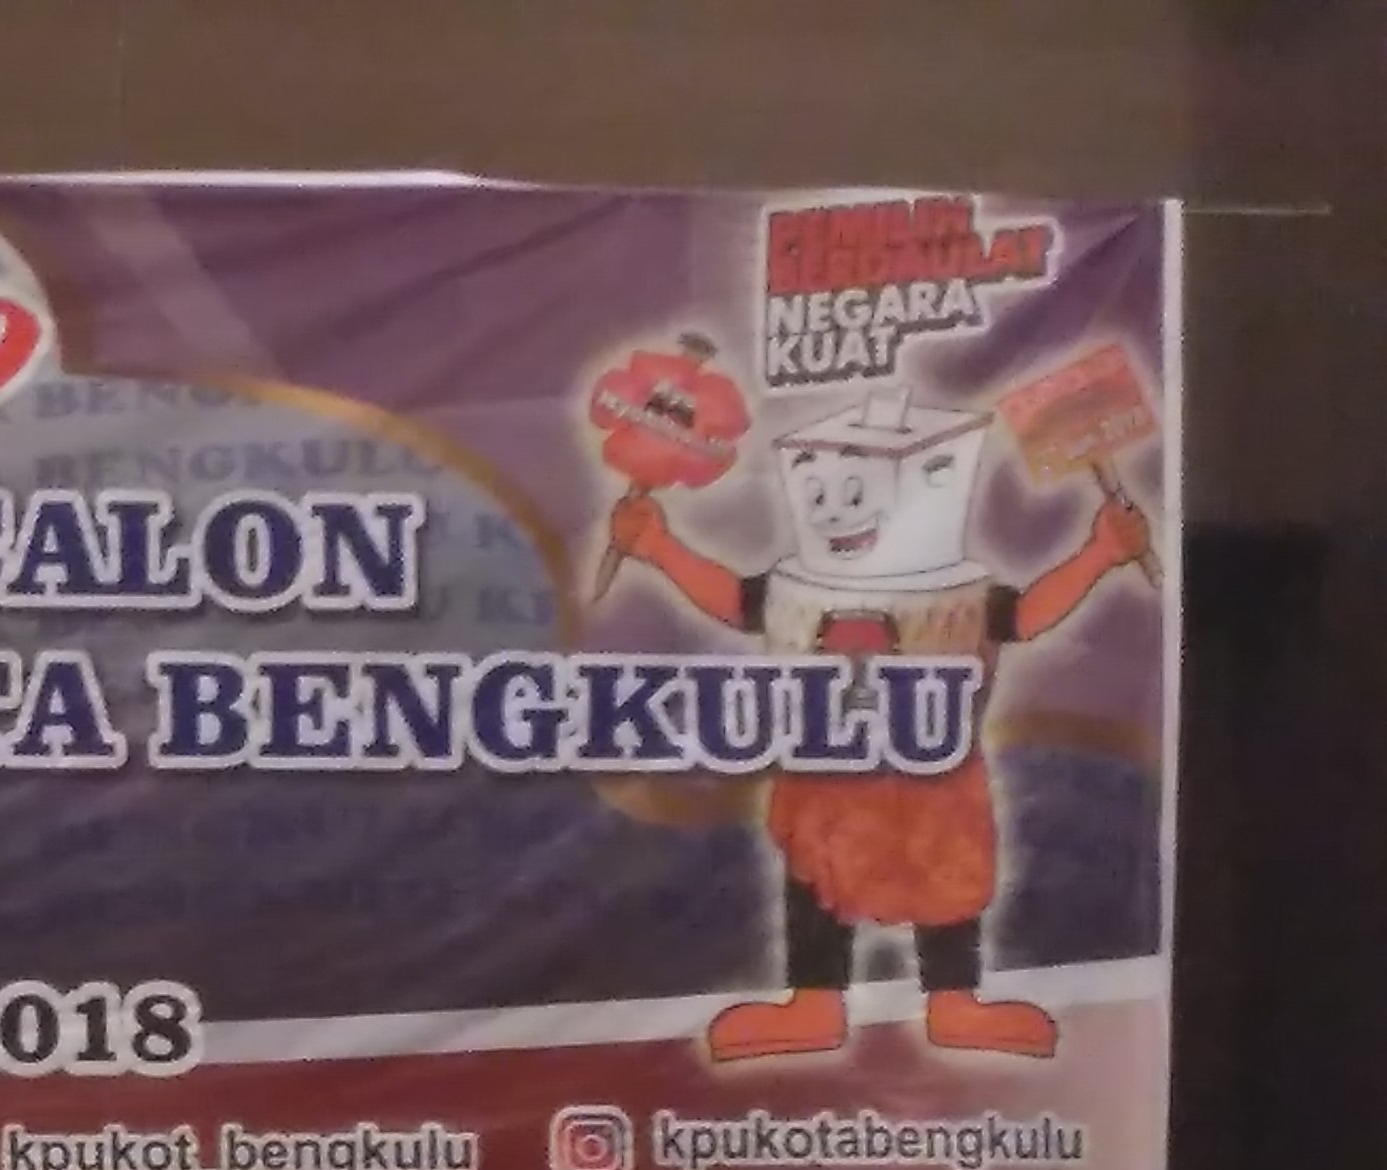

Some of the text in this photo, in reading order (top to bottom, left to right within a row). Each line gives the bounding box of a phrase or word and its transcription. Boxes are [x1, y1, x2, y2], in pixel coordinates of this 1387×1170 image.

[768, 277, 975, 335] NEGARA
[768, 325, 895, 378] KUAT
[157, 660, 975, 763] BENGKULU
